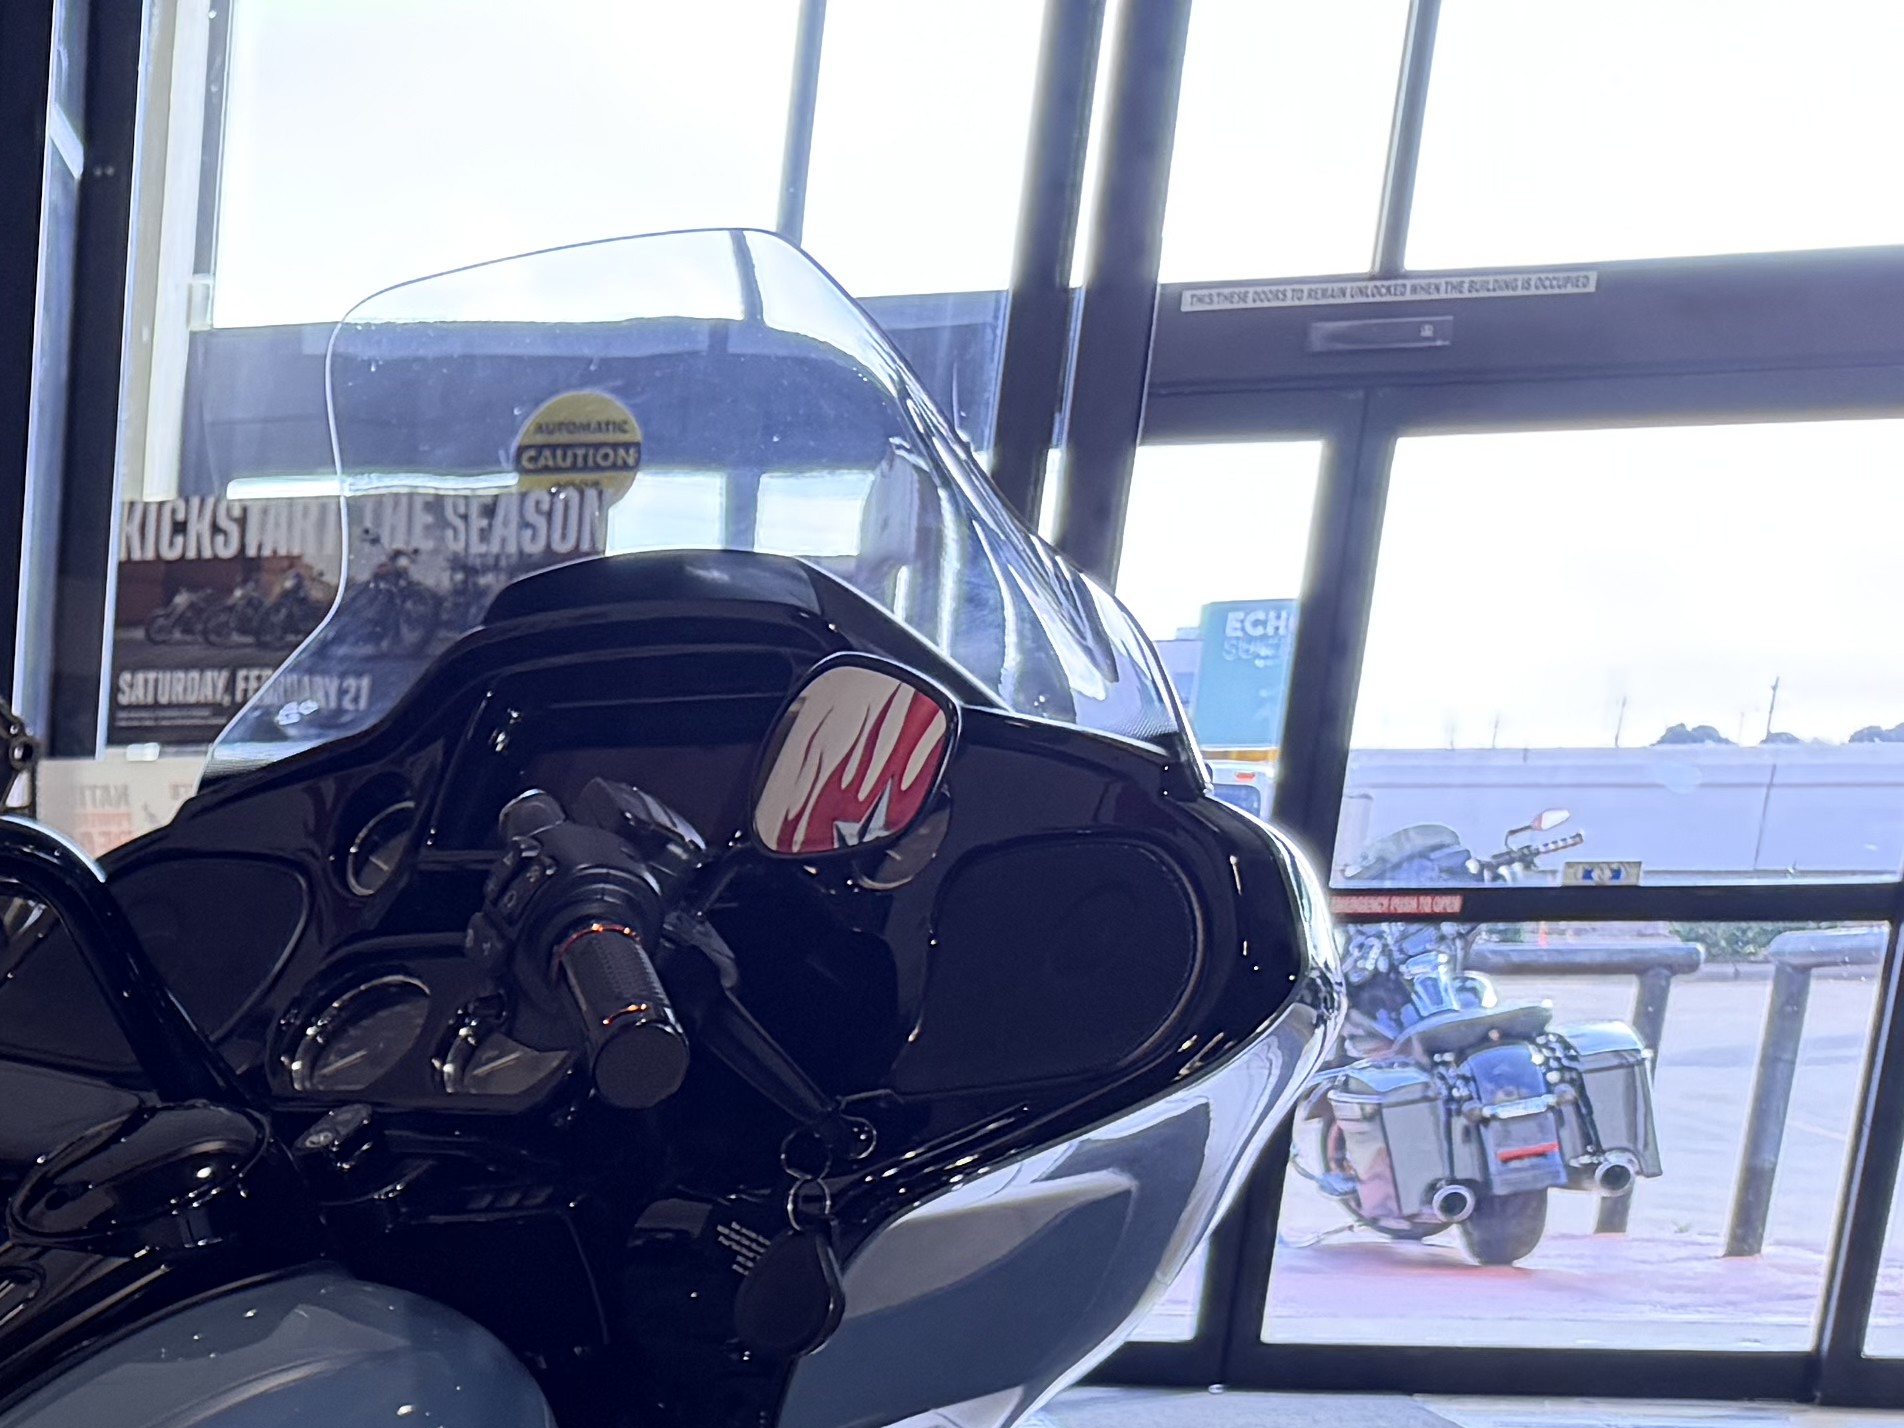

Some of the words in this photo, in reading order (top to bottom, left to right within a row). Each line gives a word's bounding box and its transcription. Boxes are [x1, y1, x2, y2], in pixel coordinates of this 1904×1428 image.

[1252, 287, 1288, 303] DOORS
[1291, 287, 1304, 301] TO
[1350, 283, 1407, 299] UNLOCKED
[1410, 281, 1440, 296] WHEN
[1444, 279, 1466, 295] THE
[1468, 277, 1518, 293] BUILDING
[1521, 277, 1532, 291] IS
[1534, 275, 1590, 290] OCCUPIED
[533, 419, 630, 436] AUTOMATIC
[520, 447, 636, 471] CAUTION
[119, 494, 340, 562] KICKSTART
[356, 492, 434, 553] THE
[443, 486, 608, 556] SEASON
[117, 668, 232, 706] SATURDAY,
[342, 673, 372, 711] 21
